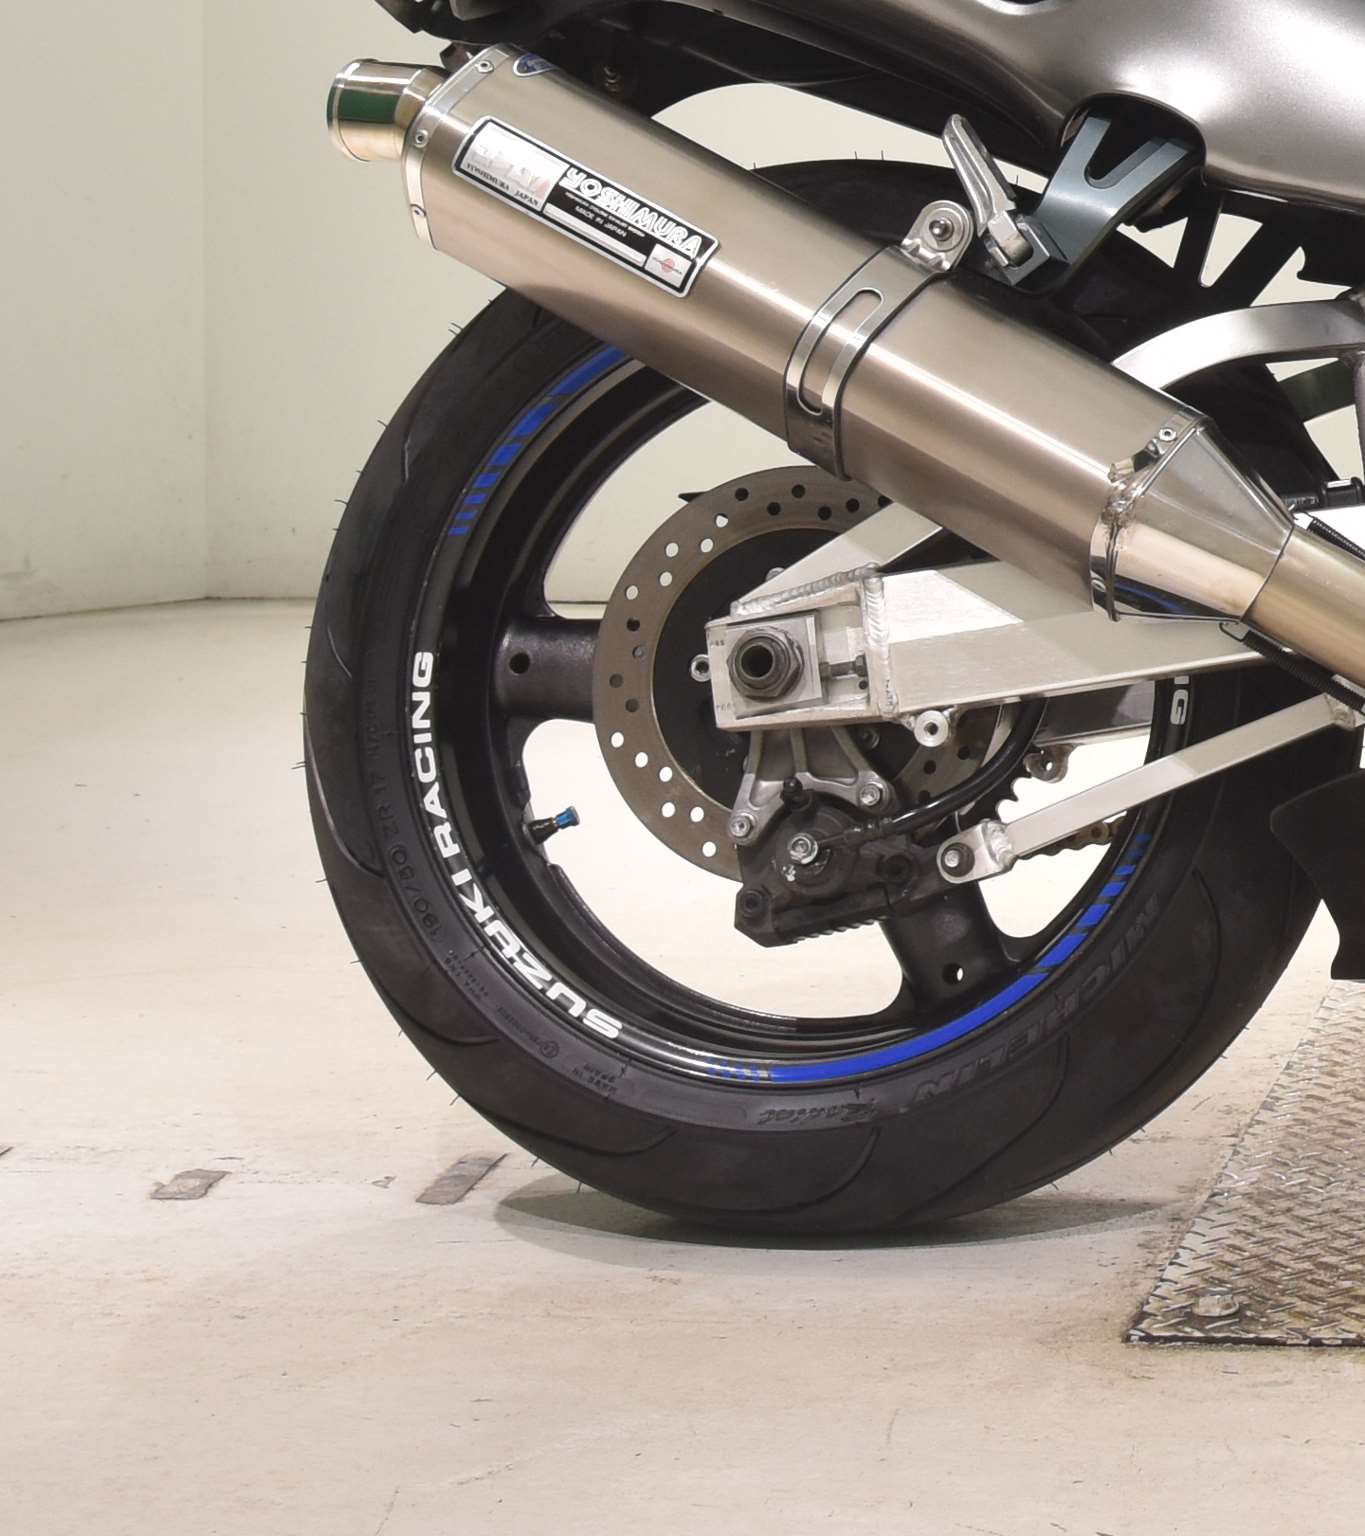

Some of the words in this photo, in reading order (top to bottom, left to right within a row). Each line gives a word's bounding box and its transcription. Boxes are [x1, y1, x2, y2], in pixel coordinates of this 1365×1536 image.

[514, 189, 539, 207] JAPAN
[558, 166, 703, 261] YOSHIMURA
[411, 651, 461, 859] RACING
[454, 868, 624, 1041] SUZUKI
